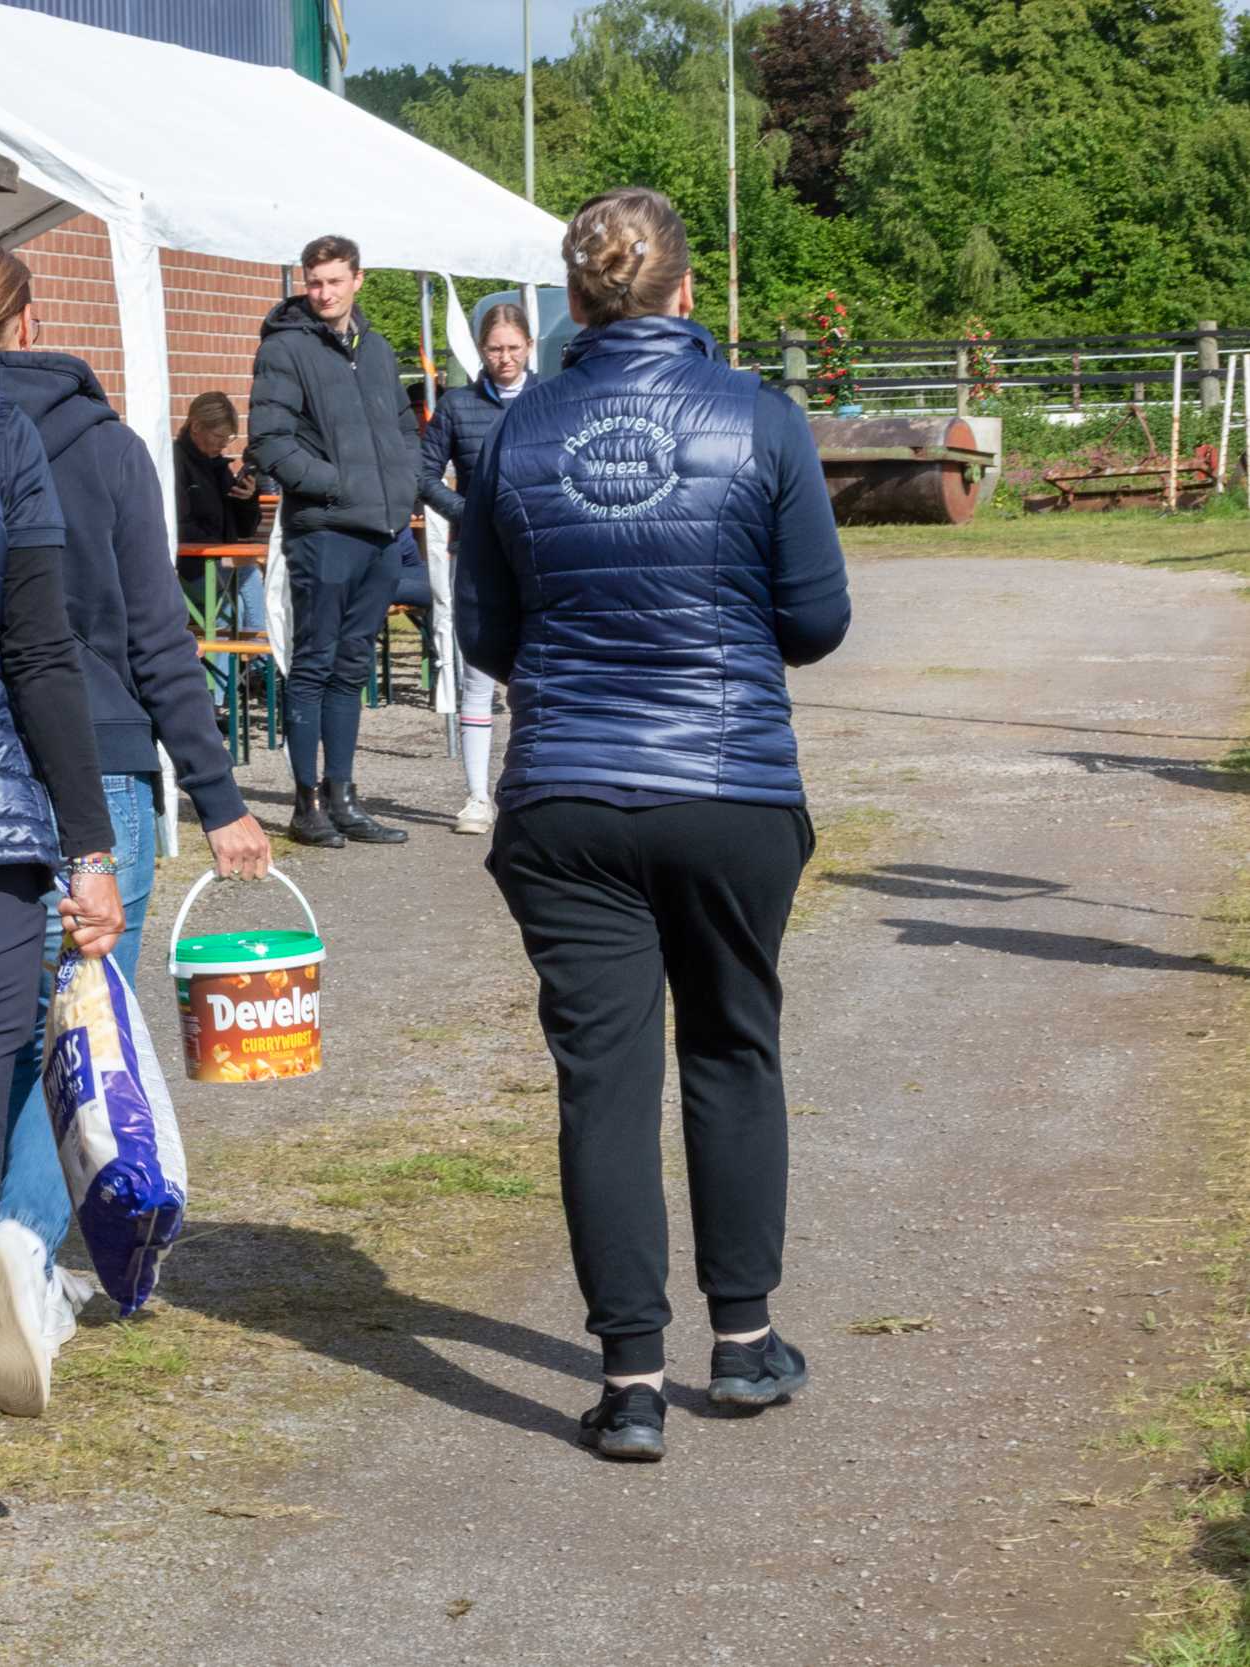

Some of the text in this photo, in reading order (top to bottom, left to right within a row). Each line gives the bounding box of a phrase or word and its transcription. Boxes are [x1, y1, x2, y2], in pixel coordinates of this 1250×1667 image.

[564, 416, 677, 456] Reiterverein
[588, 461, 648, 475] Weeze
[581, 501, 608, 517] von
[611, 471, 680, 517] Schmettow
[206, 987, 320, 1031] Develey
[241, 1031, 312, 1053] CURRYWURST
